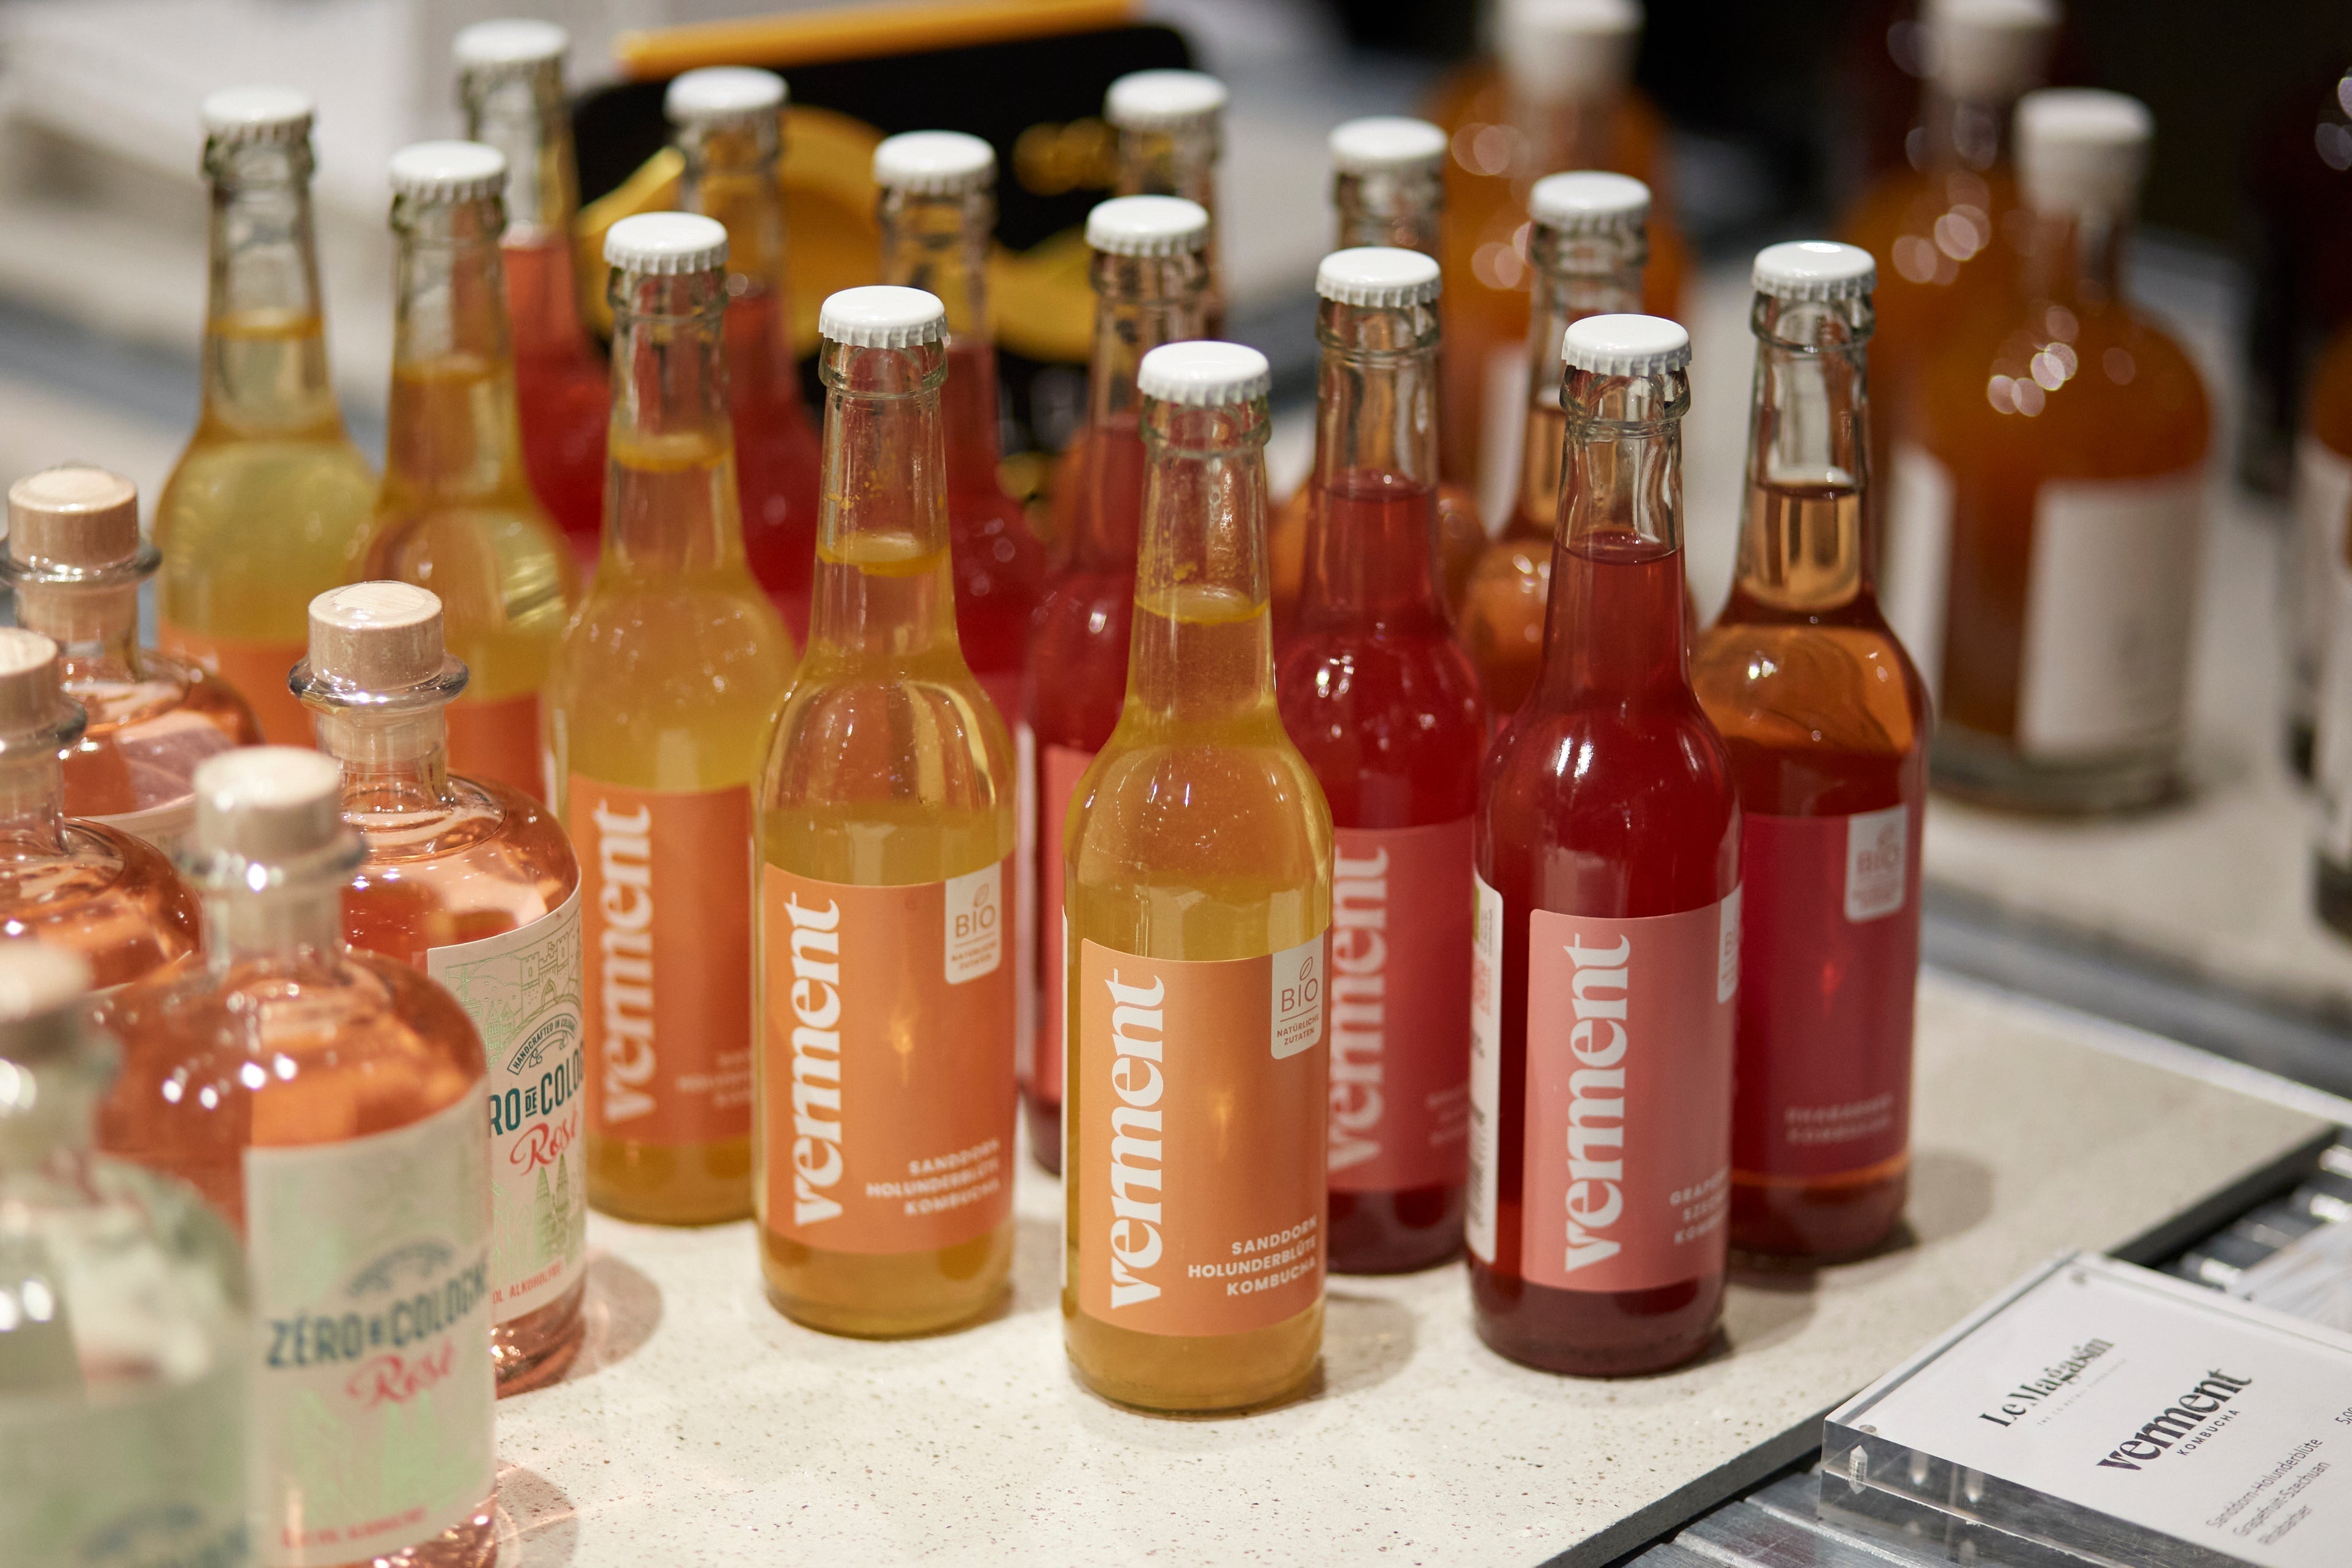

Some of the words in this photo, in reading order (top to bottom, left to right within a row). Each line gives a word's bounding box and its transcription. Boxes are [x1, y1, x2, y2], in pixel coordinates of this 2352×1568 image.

[956, 904, 995, 937] BIO
[593, 798, 656, 1122] verment
[1282, 977, 1318, 1012] BIO
[513, 1022, 553, 1069] HANDCRAFTED
[1277, 1014, 1320, 1038] NATÜRLICHE
[1284, 1027, 1314, 1046] ZUTATEN
[784, 891, 844, 1227] verment
[490, 1088, 521, 1136] RO
[525, 1092, 537, 1112] DE
[541, 1042, 583, 1116] COLO
[1563, 933, 1630, 1272] verment
[1110, 968, 1165, 1309] verment
[1188, 1235, 1316, 1278] HOLUNDERBLÜTE
[1231, 1214, 1317, 1255] SANDDORN
[493, 1289, 505, 1304] OL
[1226, 1256, 1317, 1296] KOMBUCHA
[2095, 1368, 2253, 1470] verment
[2176, 1410, 2241, 1456] KOMBUCHA
[2206, 1439, 2323, 1529] Sanddorn-Holunderblüte
[2233, 1461, 2331, 1537] Grapefruit-Szechuan
